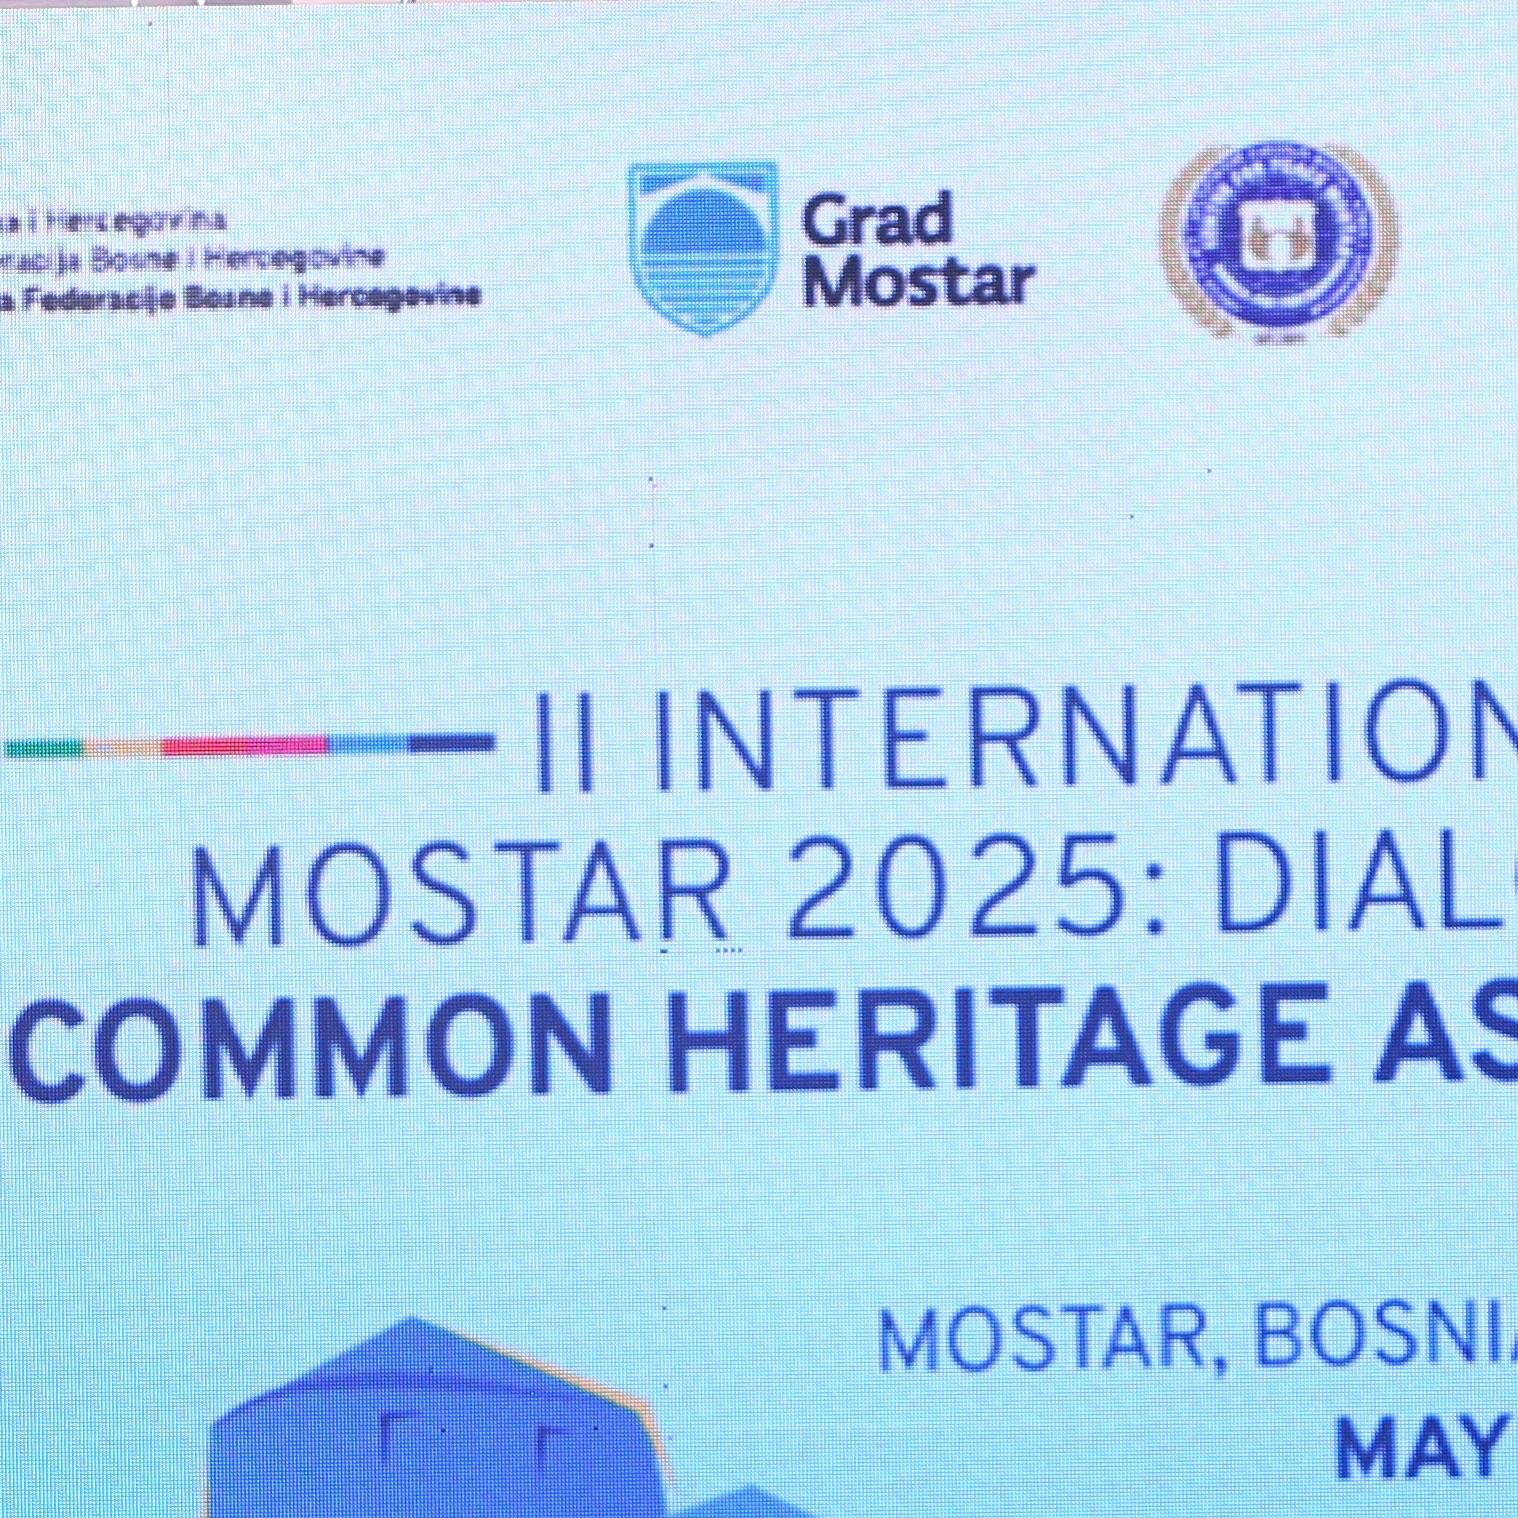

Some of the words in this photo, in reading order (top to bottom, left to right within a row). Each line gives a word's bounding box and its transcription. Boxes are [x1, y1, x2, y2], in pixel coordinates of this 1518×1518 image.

[801, 188, 954, 249] Grad
[802, 252, 1038, 309] Mostar
[536, 690, 594, 795] II
[192, 837, 731, 949] MOSTAR
[787, 831, 1165, 941] 2025:
[7, 991, 613, 1106] COMMON
[667, 980, 1334, 1095] HERITAGE
[878, 1300, 1229, 1379] MOSTAR,
[1335, 1413, 1512, 1481] MAY
